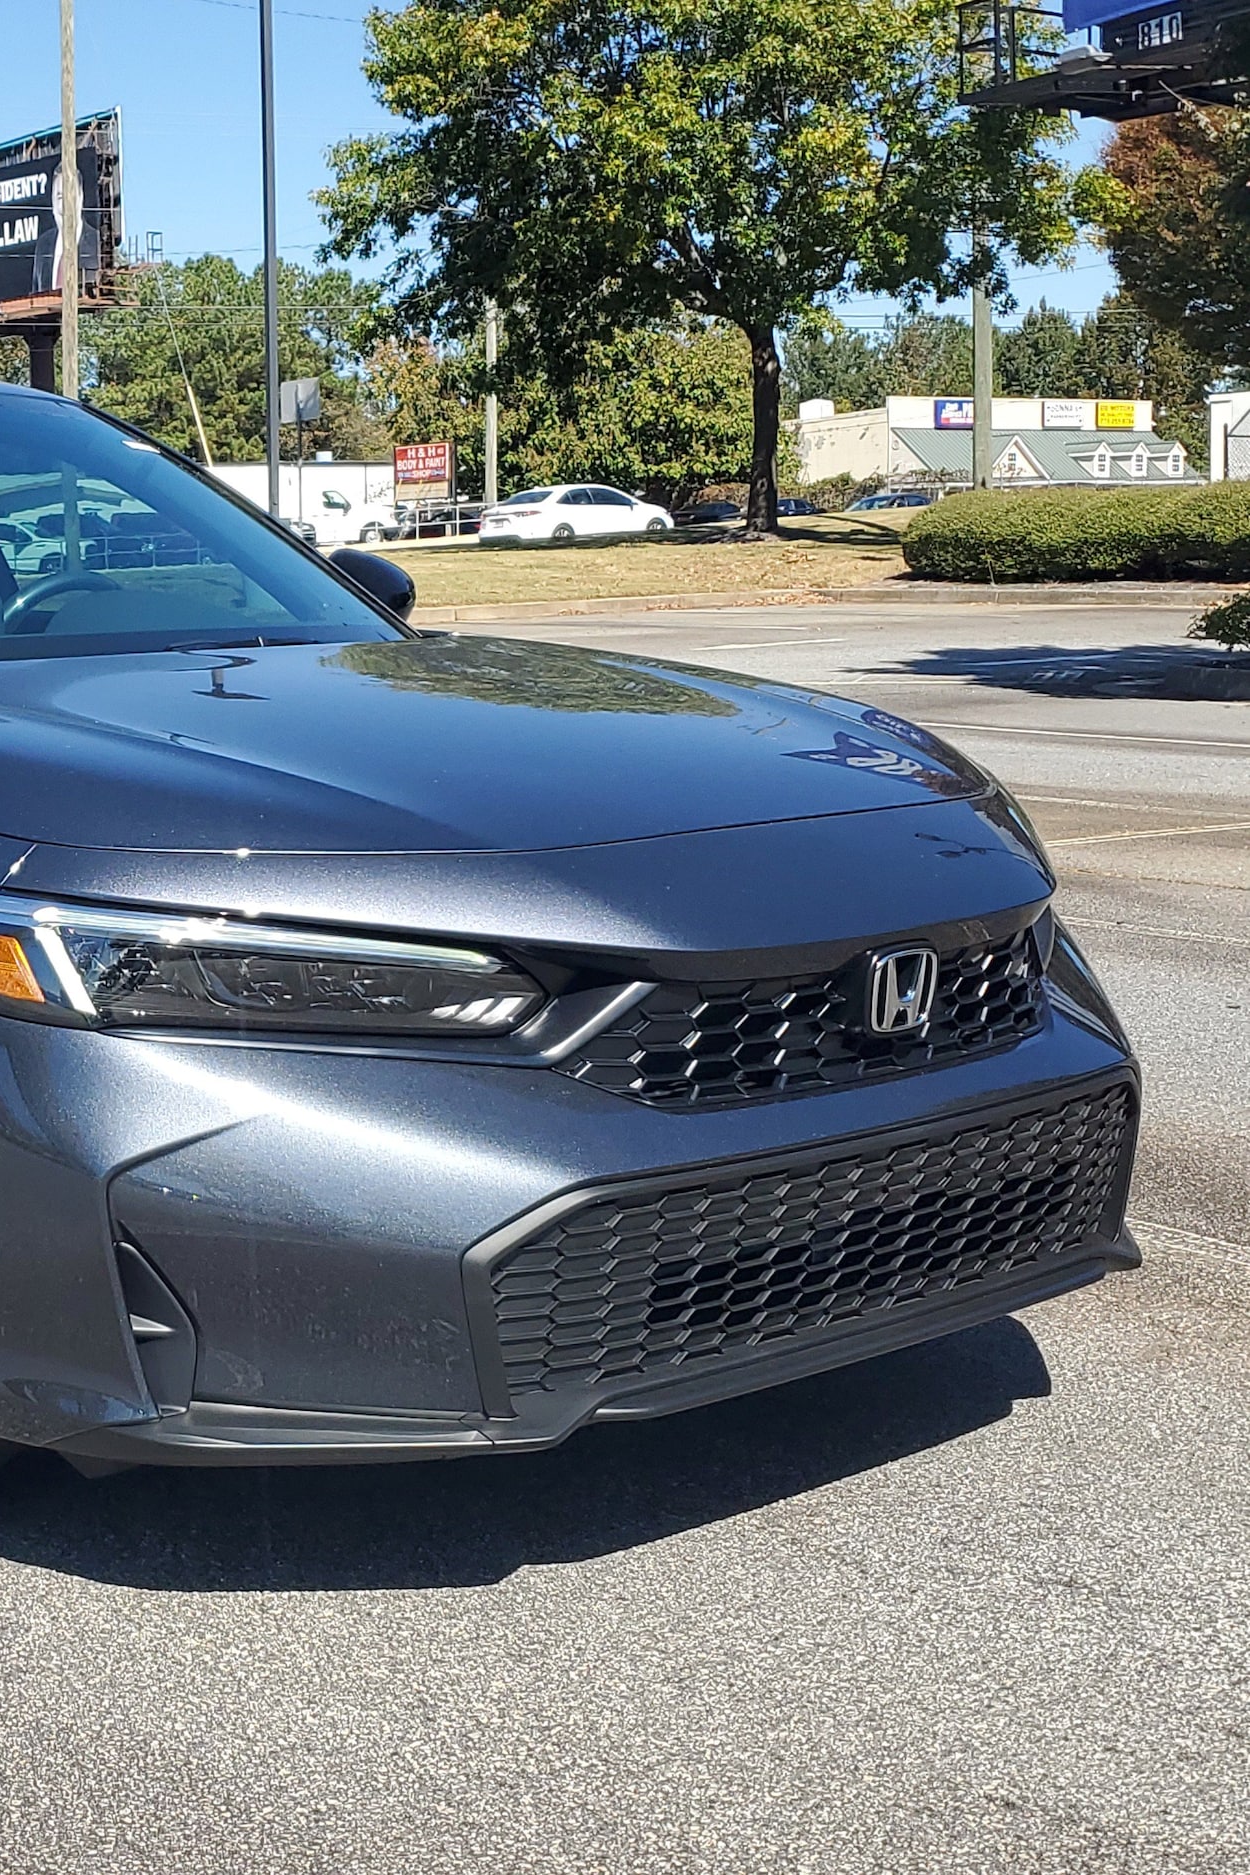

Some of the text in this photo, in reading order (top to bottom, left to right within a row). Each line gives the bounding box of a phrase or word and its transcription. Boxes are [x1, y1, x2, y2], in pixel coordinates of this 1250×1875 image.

[407, 448, 416, 459] H
[418, 447, 425, 458] &
[427, 446, 436, 457] H
[397, 459, 417, 471] BODY
[425, 456, 445, 468] PAINT
